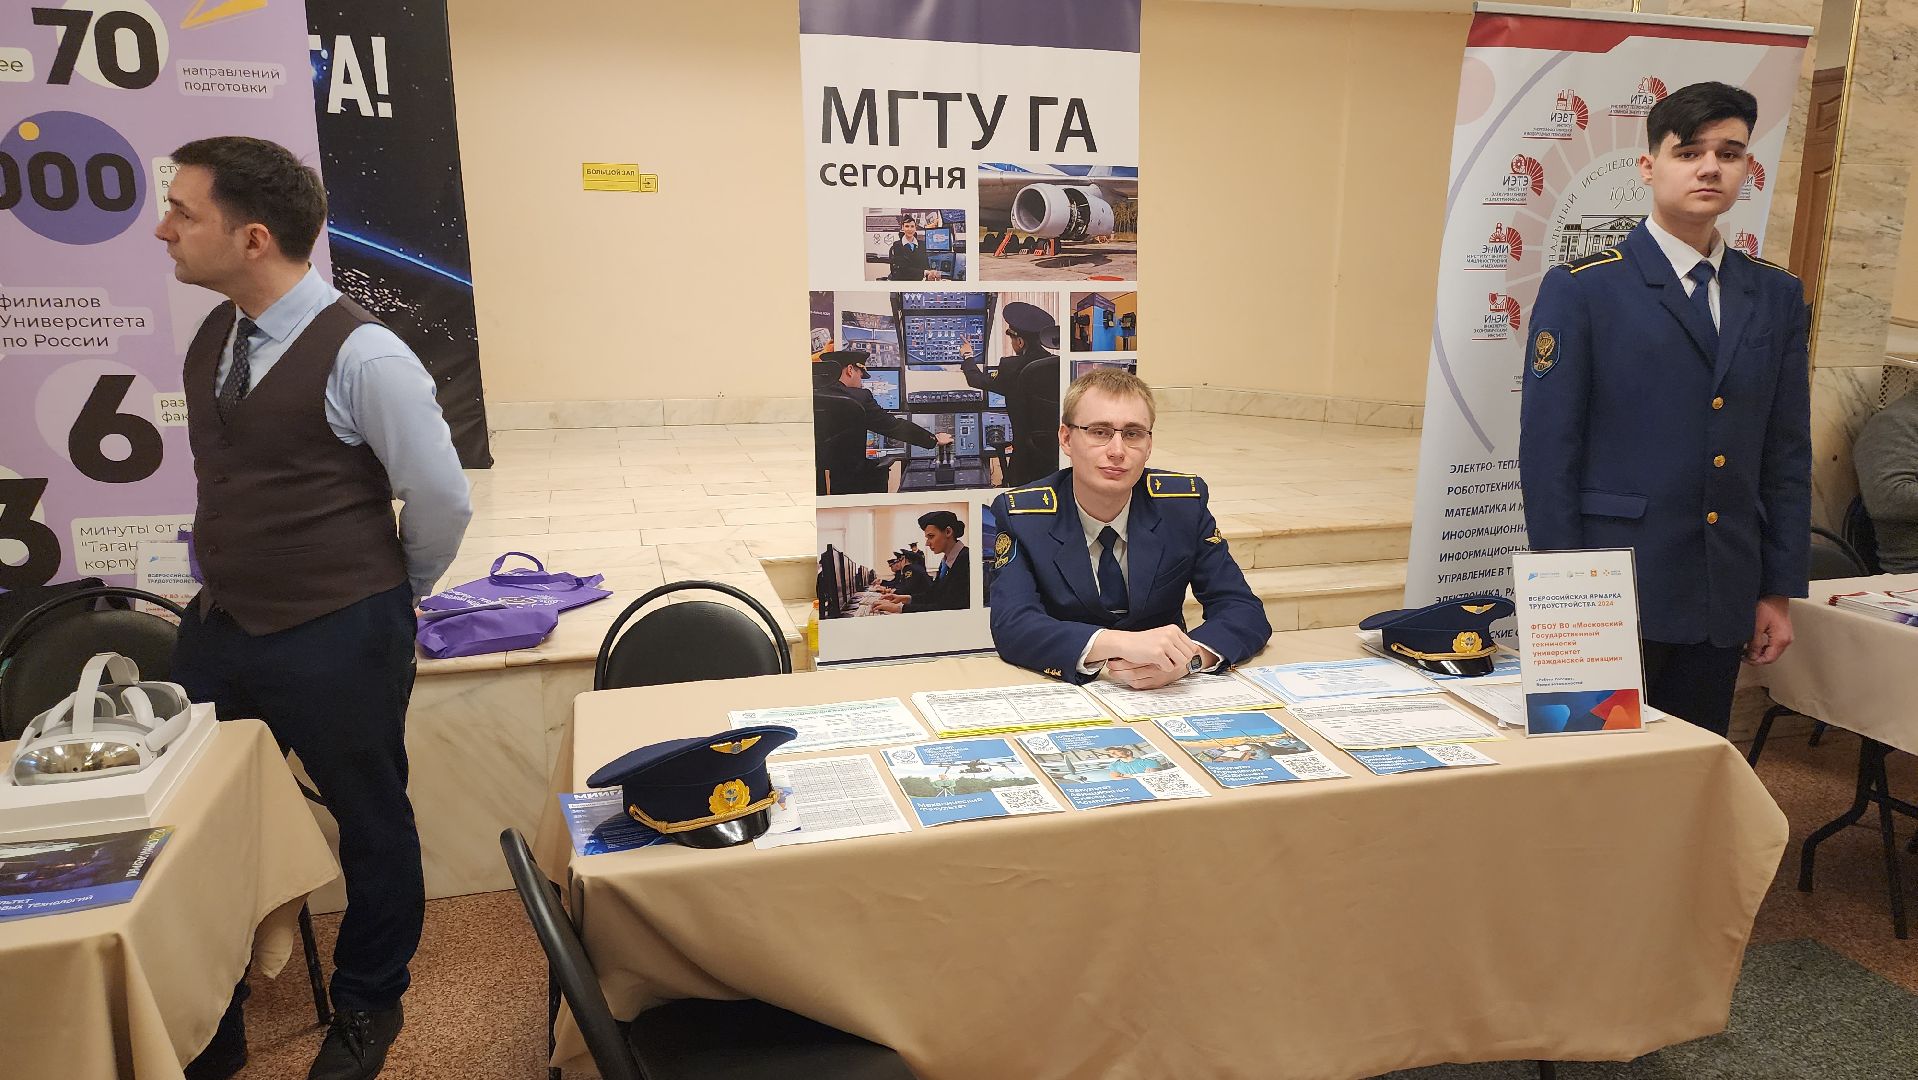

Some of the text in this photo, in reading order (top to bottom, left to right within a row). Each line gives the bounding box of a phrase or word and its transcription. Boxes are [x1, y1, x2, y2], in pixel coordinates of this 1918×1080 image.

[32, 8, 160, 90] 70
[0, 59, 24, 73] ее
[182, 65, 281, 80] направлений
[184, 80, 268, 94] подготовки
[1630, 94, 1654, 105] ИТАЭ
[821, 86, 1098, 153] МГТУ ГА
[1550, 112, 1575, 123] ИЭВТ
[586, 168, 620, 176] БОЛЬШОЙ
[819, 162, 966, 195] сегодня
[1502, 175, 1529, 186] ИЭТЭ
[1609, 179, 1646, 209] 1930
[1482, 244, 1509, 254] ЭнМИ
[0, 293, 101, 311] филиалов
[1, 315, 145, 330] Университета
[3, 334, 109, 347] по России
[160, 398, 185, 409] раз
[161, 411, 188, 425] фак
[68, 375, 163, 483] 6
[1449, 459, 1520, 474] ЭЛЕКТРО- ТЕПЛ
[1447, 480, 1521, 496] РОБОТОТЕХНИК
[1444, 503, 1507, 517] МАТЕМАТИКА
[1508, 502, 1517, 512] И
[80, 525, 150, 538] минуты
[155, 524, 173, 533] от
[1441, 524, 1527, 540] ИНФОРМАЦИОНН
[81, 541, 138, 553] "Таган
[1439, 544, 1531, 562] ИНФОРМАЦИОННЫ
[85, 558, 138, 571] корпу
[1437, 568, 1497, 584] УПРАВЛЕНИЕ
[1507, 566, 1513, 575] Т
[1505, 587, 1515, 597] РА
[1528, 592, 1622, 602] ВСЕРОССИЙСКАЯ ЯРМАРКА
[1528, 601, 1597, 610] ТРУДОУСТРОЙСТВА
[1489, 629, 1513, 639] СКИЕ
[1531, 630, 1600, 640] Государственный
[1533, 649, 1581, 657] университет
[1533, 656, 1584, 666] гражданской
